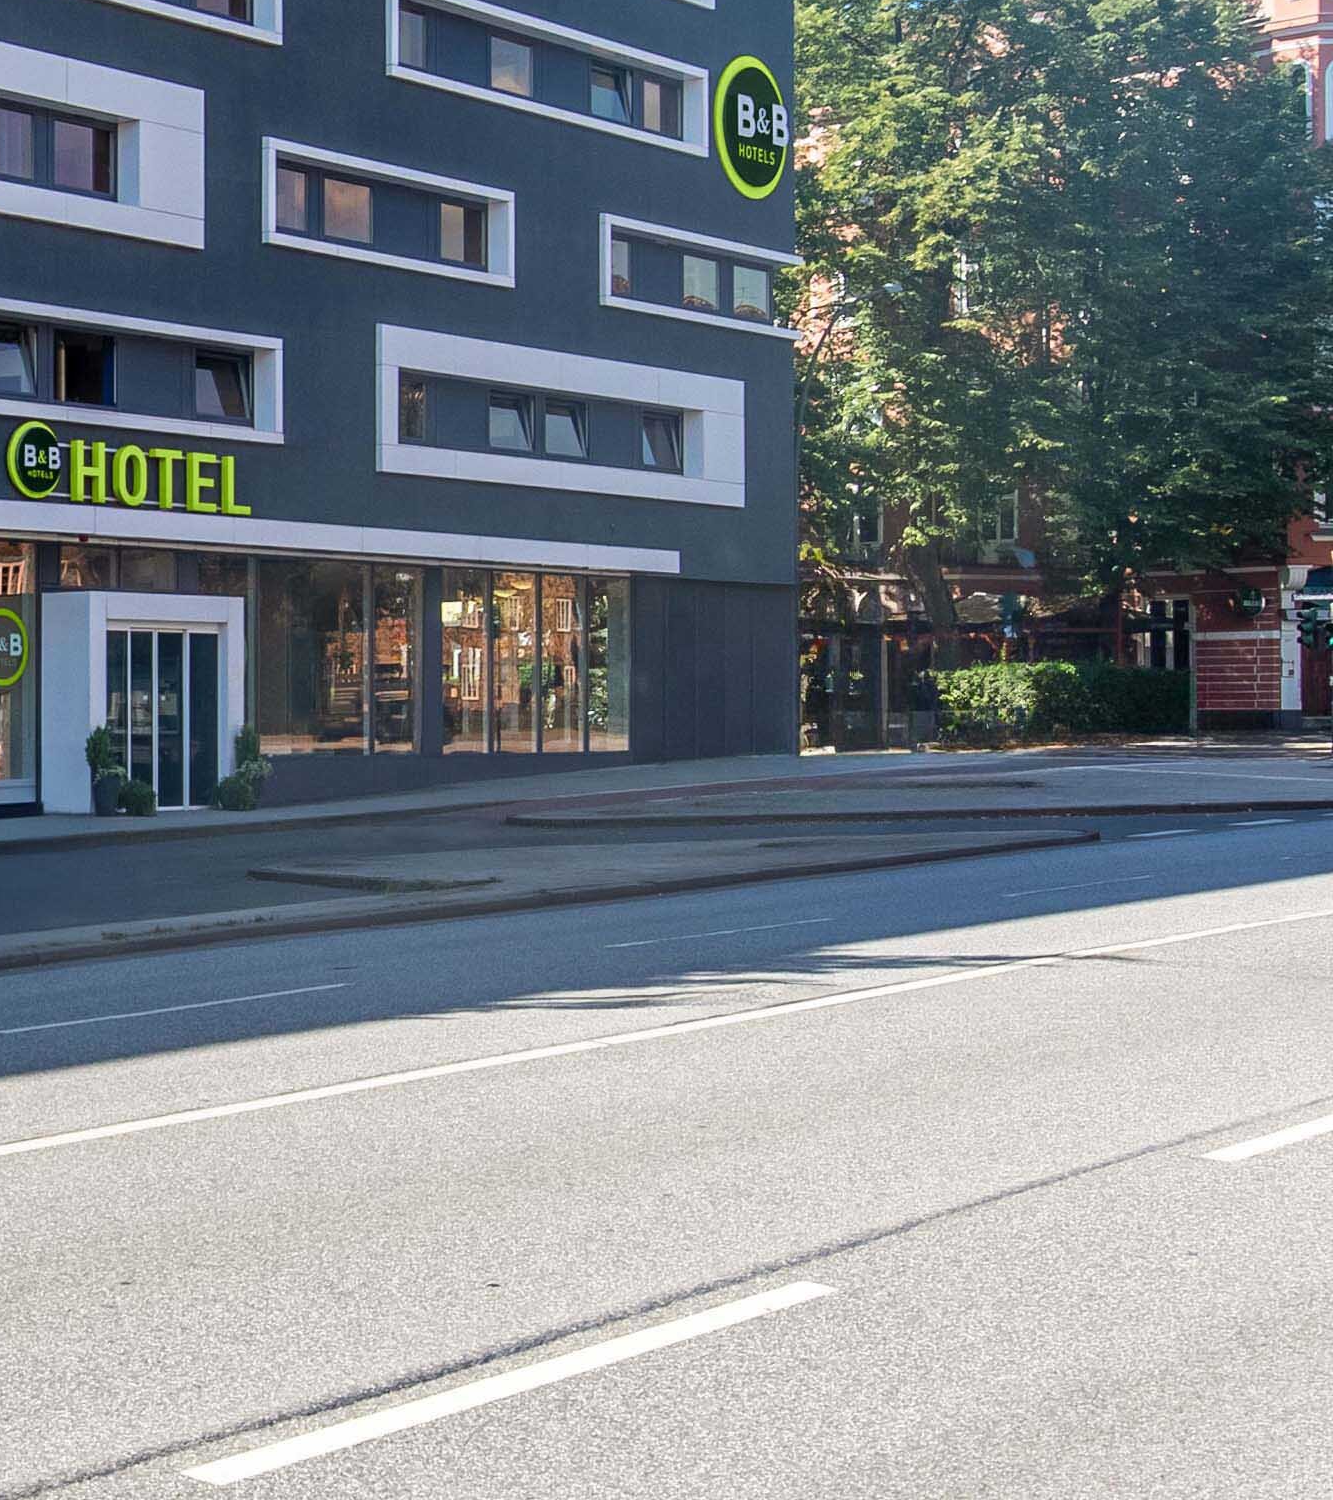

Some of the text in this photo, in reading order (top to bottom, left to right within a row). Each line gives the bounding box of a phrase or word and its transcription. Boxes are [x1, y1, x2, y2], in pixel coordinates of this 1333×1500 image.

[737, 93, 789, 147] B&B
[738, 143, 775, 165] HOTELS
[24, 443, 61, 469] B&B
[70, 439, 252, 516] HOTEL
